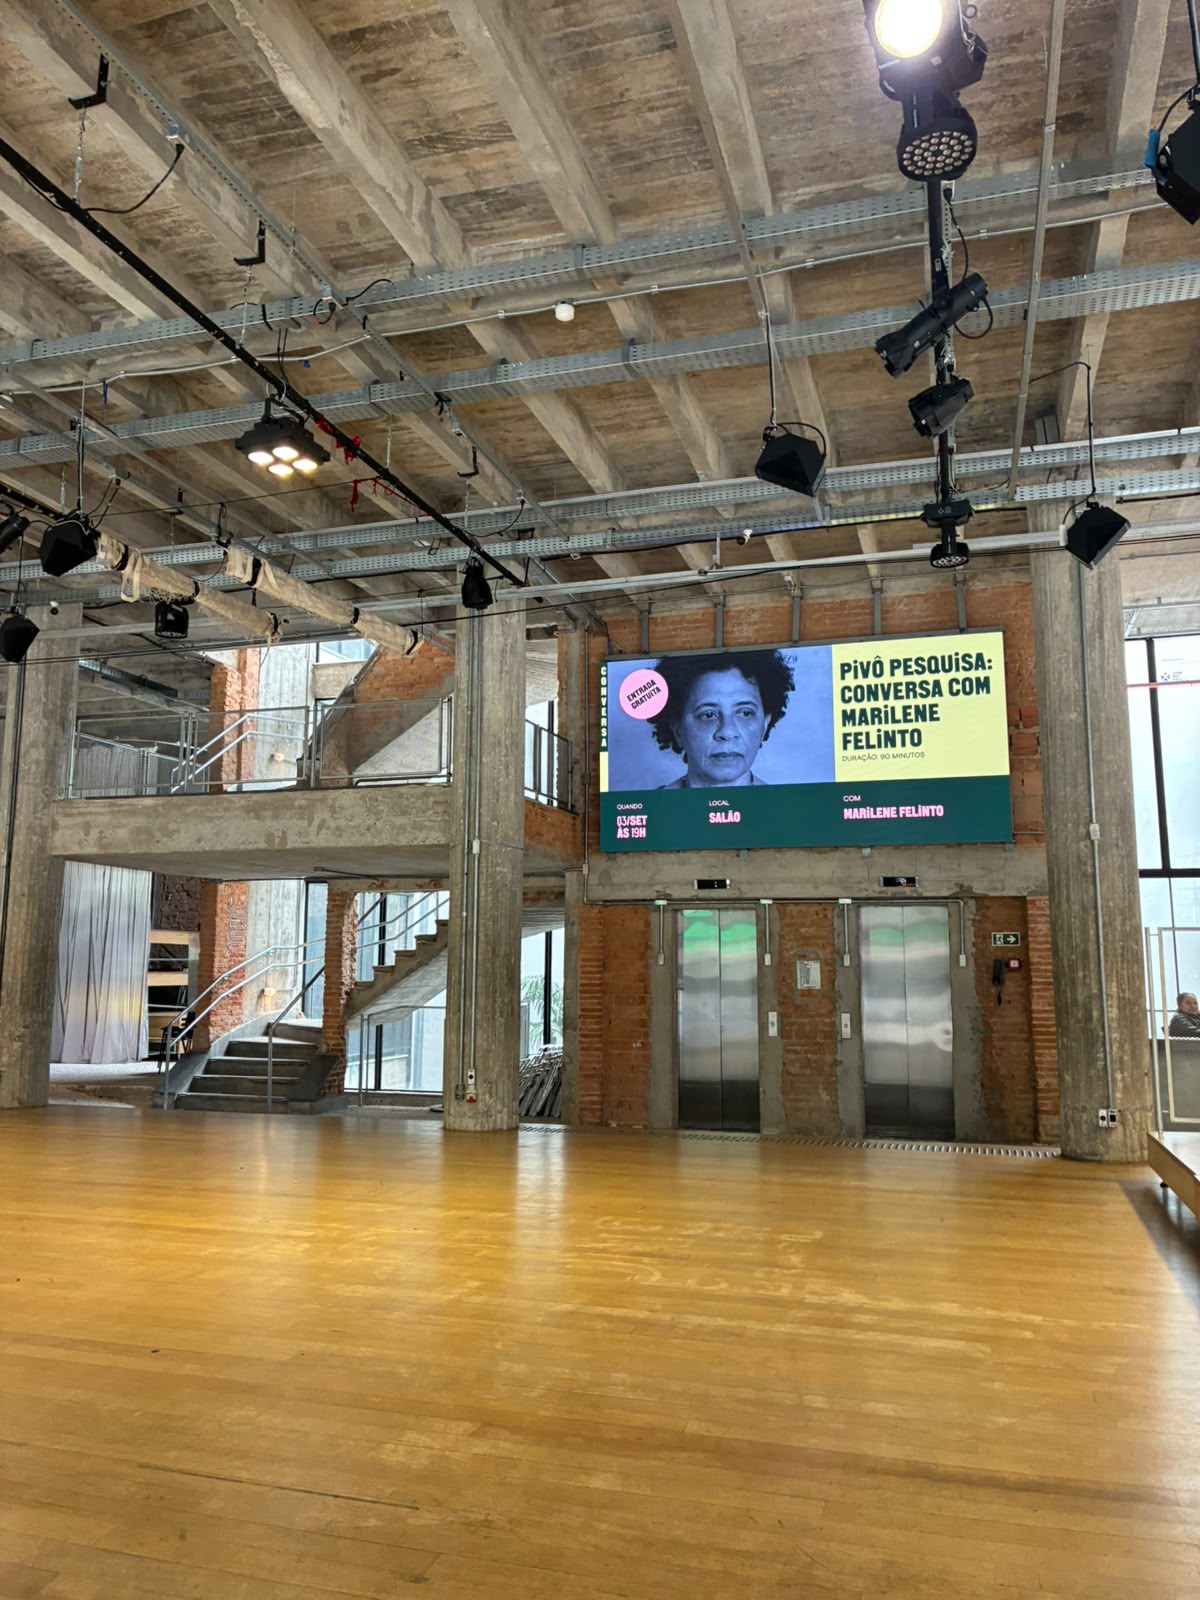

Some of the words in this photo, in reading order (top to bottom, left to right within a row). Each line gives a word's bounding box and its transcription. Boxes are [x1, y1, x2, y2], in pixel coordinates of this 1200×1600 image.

[627, 679, 656, 702] ENTRADA
[840, 679, 944, 704] CONVERSA
[948, 676, 991, 697] COM
[842, 753, 878, 762] DURAÇÃO:
[616, 803, 643, 811] QUANDO
[616, 815, 648, 826] 03/SET
[708, 810, 741, 823] SALÃO
[631, 827, 646, 838] 19H
